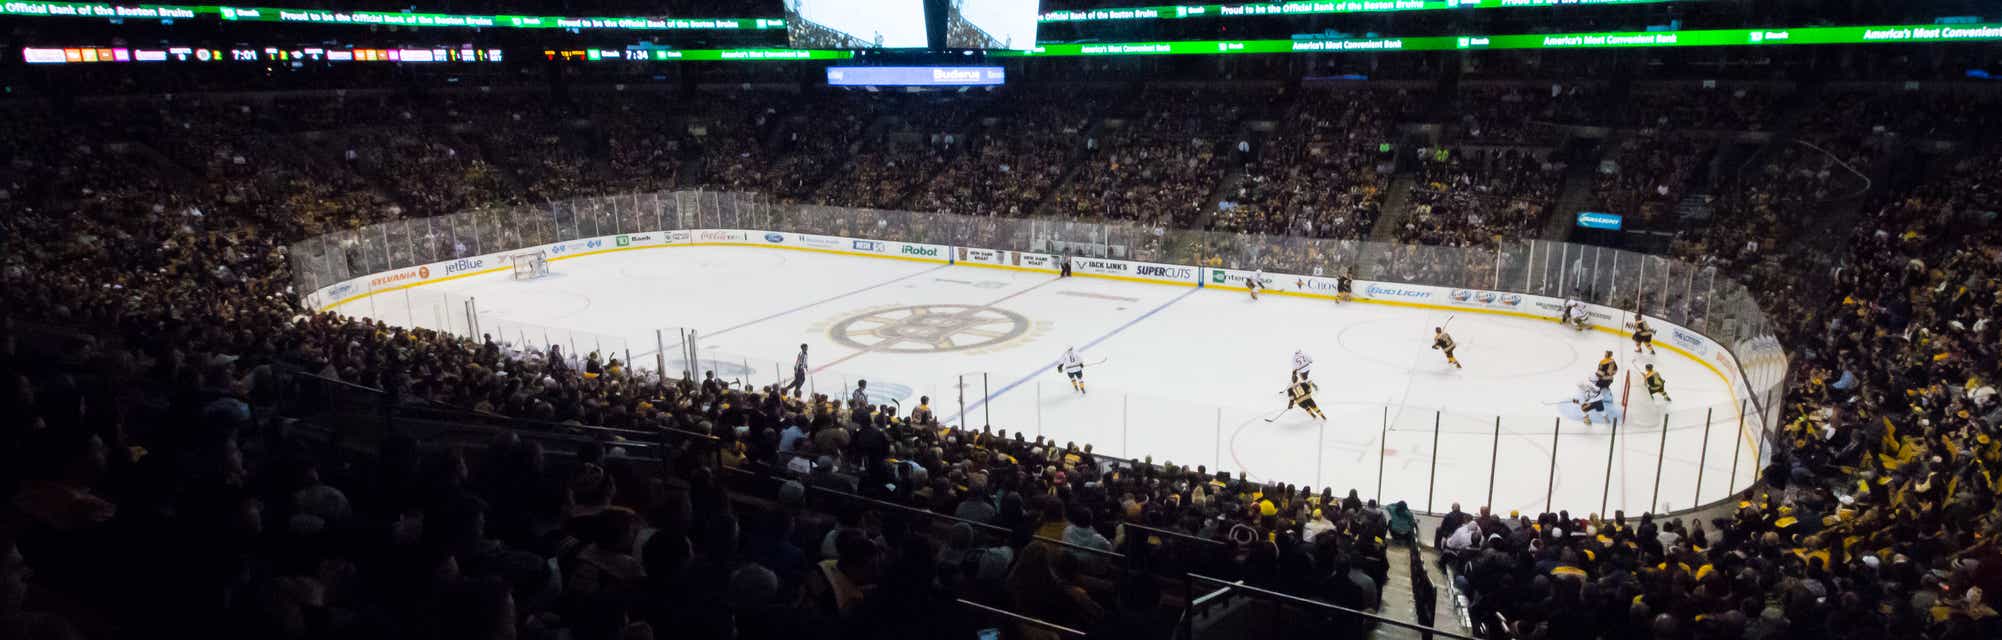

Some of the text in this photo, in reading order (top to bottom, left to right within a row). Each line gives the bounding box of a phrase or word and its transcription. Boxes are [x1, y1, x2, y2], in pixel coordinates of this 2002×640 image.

[5, 2, 194, 18] Official Bank of the Boston Bruins
[1221, 6, 1243, 15] Proud
[1245, 5, 1254, 14] to
[1255, 5, 1266, 14] be
[1267, 5, 1280, 13] the
[1282, 3, 1313, 13] Official
[1314, 2, 1334, 11] Bank
[1336, 2, 1345, 11] of
[1348, 2, 1362, 10] the
[1364, 1, 1394, 10] Boston
[280, 11, 309, 20] Proud
[309, 12, 320, 20] to
[321, 12, 335, 21] be
[335, 13, 351, 21] the
[352, 13, 383, 23] Official
[383, 15, 405, 23] Bank
[418, 16, 433, 24] the
[434, 16, 465, 24] Boston
[466, 17, 493, 25] Bruins
[1045, 12, 1068, 20] Official
[1070, 12, 1086, 20] Bank
[1088, 11, 1096, 19] of
[1097, 11, 1108, 19] the
[1110, 11, 1134, 19] Boston
[1135, 9, 1157, 18] Bruins
[557, 19, 581, 27] Proud
[619, 20, 646, 28] Official
[1544, 33, 1677, 46] America's Most Convenient Bank
[1864, 29, 1911, 40] America's
[1912, 28, 1940, 39] Most
[1081, 45, 1107, 53] America's
[1123, 44, 1156, 53] Convenient
[1293, 39, 1402, 50] America's Most Convenient Bank
[232, 50, 257, 60] 7:01
[625, 50, 648, 60] 7:34
[933, 69, 980, 81] Buderus
[901, 245, 938, 257] iRobot
[445, 259, 483, 275] jetBlue
[1088, 261, 1104, 269] JACK
[1136, 265, 1191, 280] SUPERCUTS
[371, 271, 416, 287] SYLVANIA
